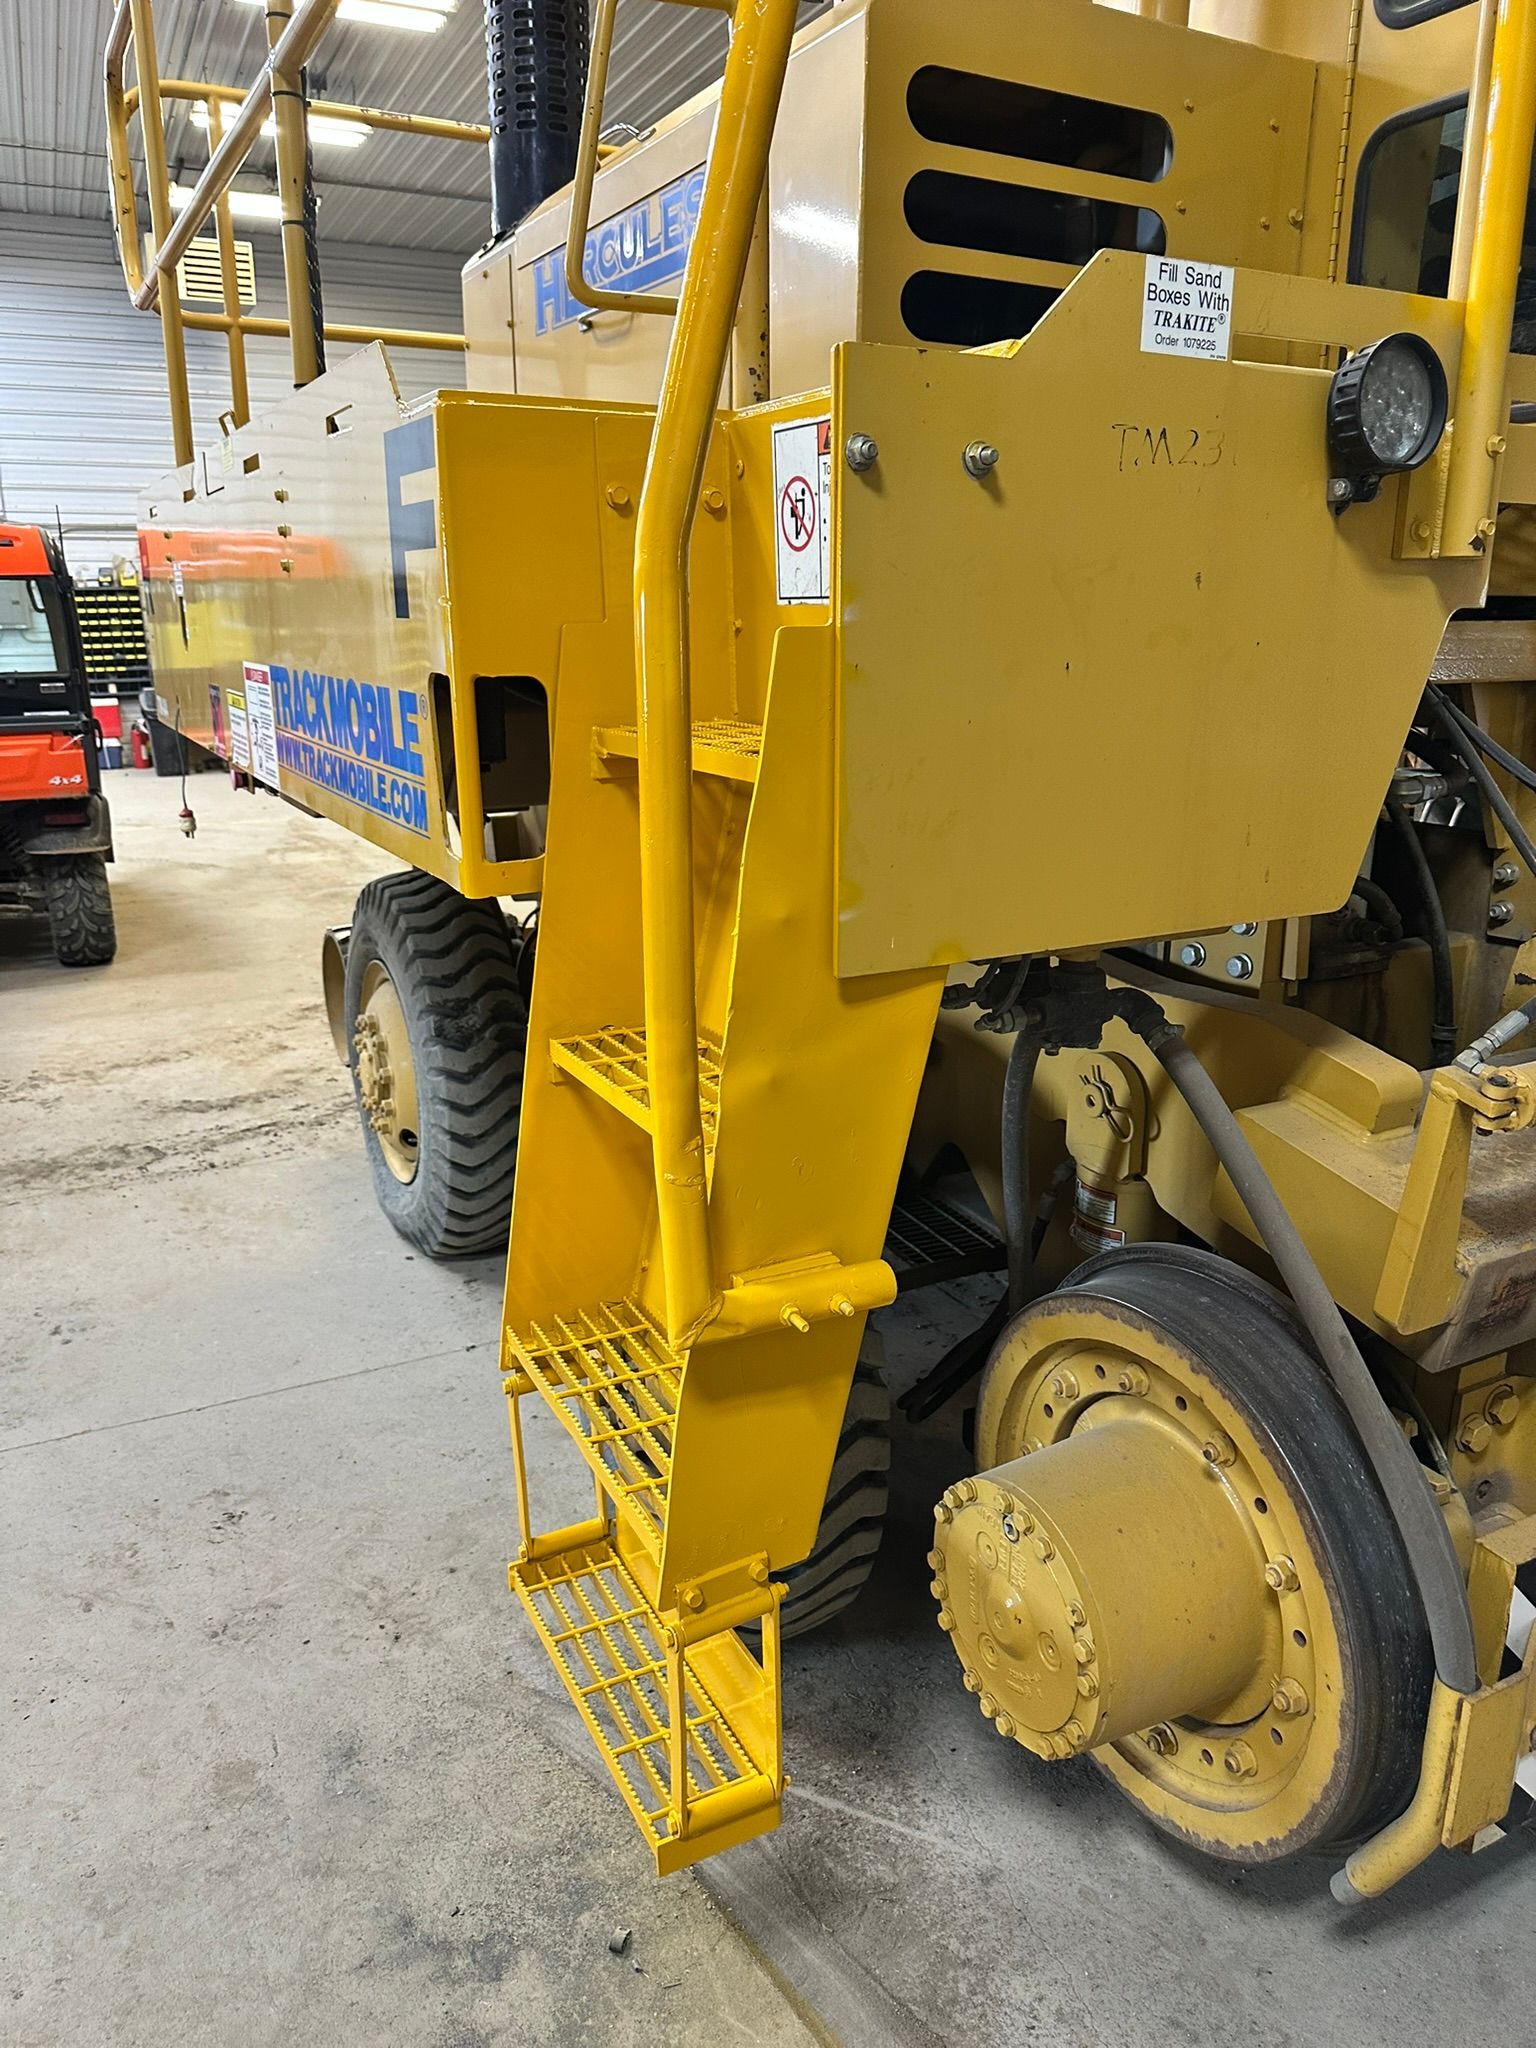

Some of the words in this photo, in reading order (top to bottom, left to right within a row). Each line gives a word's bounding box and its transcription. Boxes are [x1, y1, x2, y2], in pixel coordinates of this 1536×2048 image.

[1159, 262, 1178, 282] Fill
[1185, 266, 1222, 289] Sand
[1147, 282, 1191, 306] Boxes
[1198, 290, 1230, 312] With
[1155, 333, 1179, 347] Order
[1183, 337, 1217, 351] 1079225
[383, 414, 437, 619] F
[275, 732, 428, 832] WWW.TRACKMOBILE.COM
